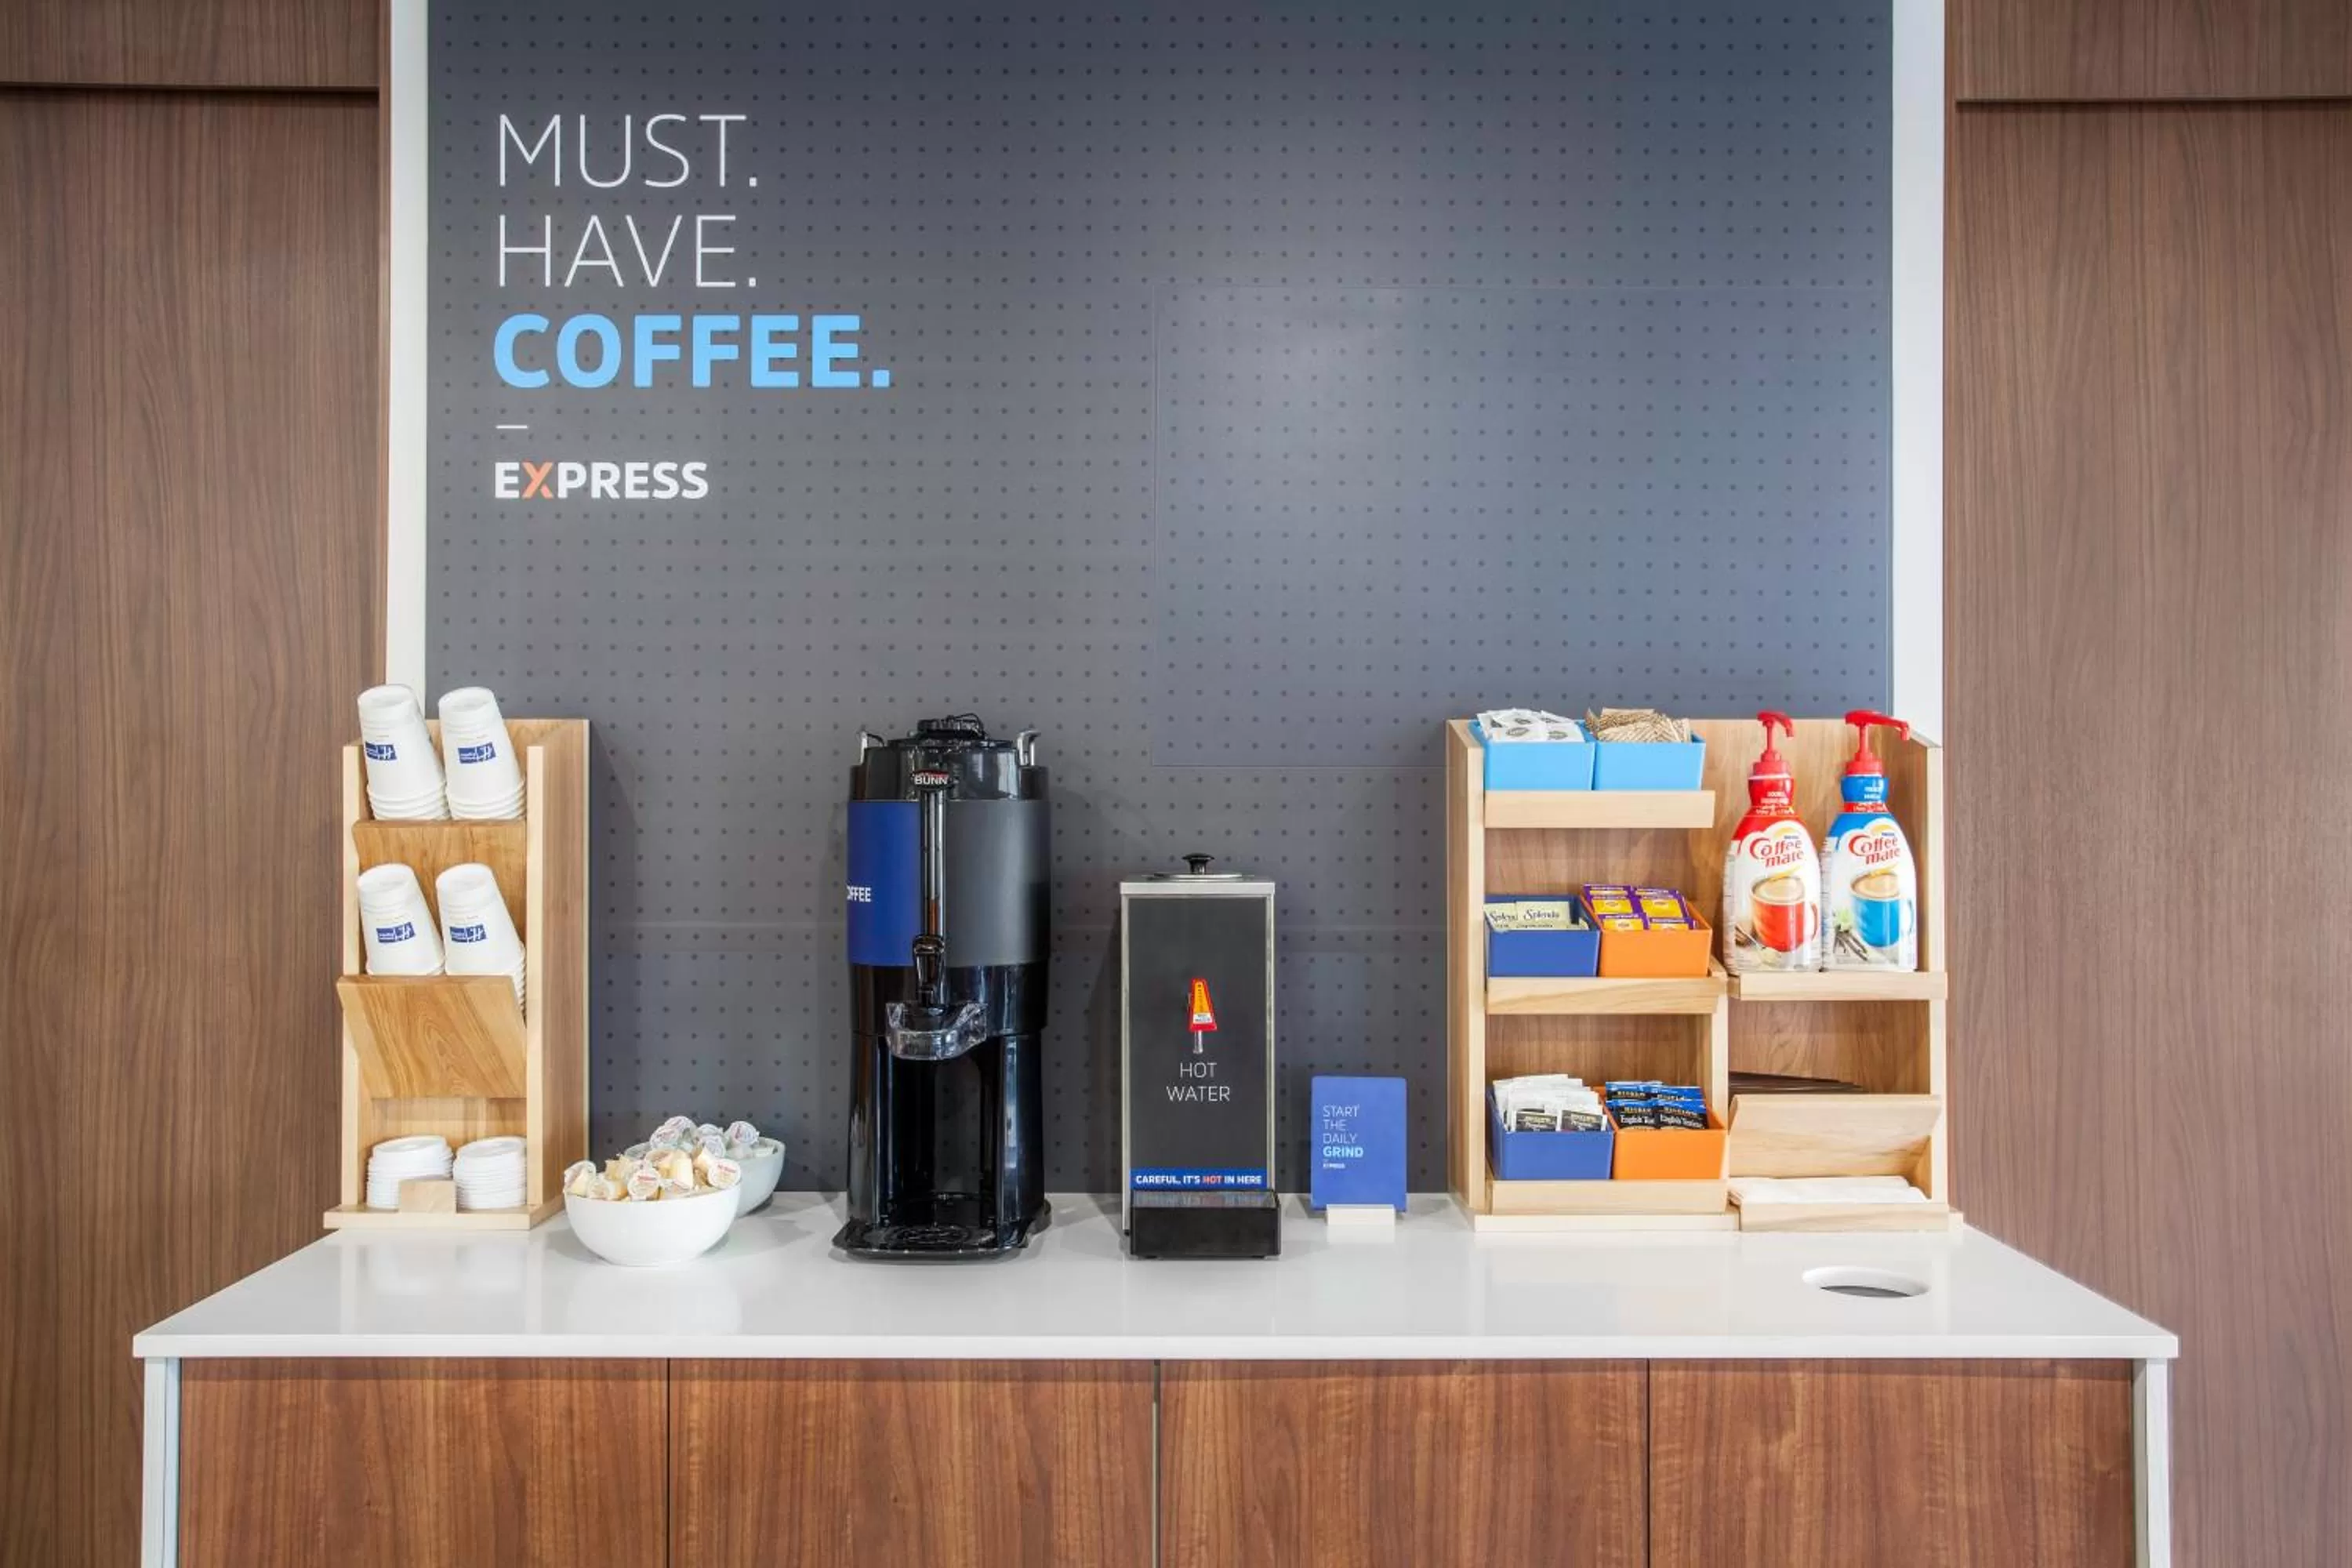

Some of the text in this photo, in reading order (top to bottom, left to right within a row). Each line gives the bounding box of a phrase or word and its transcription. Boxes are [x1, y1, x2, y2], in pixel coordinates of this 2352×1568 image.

[499, 114, 757, 187] MUST.
[499, 214, 757, 287] HAVE.
[493, 314, 891, 388] COFFEE.
[494, 461, 709, 499] EXPRESS
[914, 772, 949, 785] BUNN
[1750, 838, 1802, 859] Coffee
[1848, 834, 1898, 857] Coffee
[1179, 1062, 1218, 1079] HOT
[1166, 1086, 1230, 1102] WATER
[1323, 1105, 1359, 1117] START
[1323, 1119, 1346, 1131] THE
[1323, 1133, 1357, 1145] DAILY
[1323, 1146, 1364, 1158] GRIND
[1183, 1175, 1201, 1185] IT'S
[1203, 1175, 1222, 1185] HOT
[1224, 1175, 1235, 1185] IN
[1236, 1175, 1261, 1185] HERE
